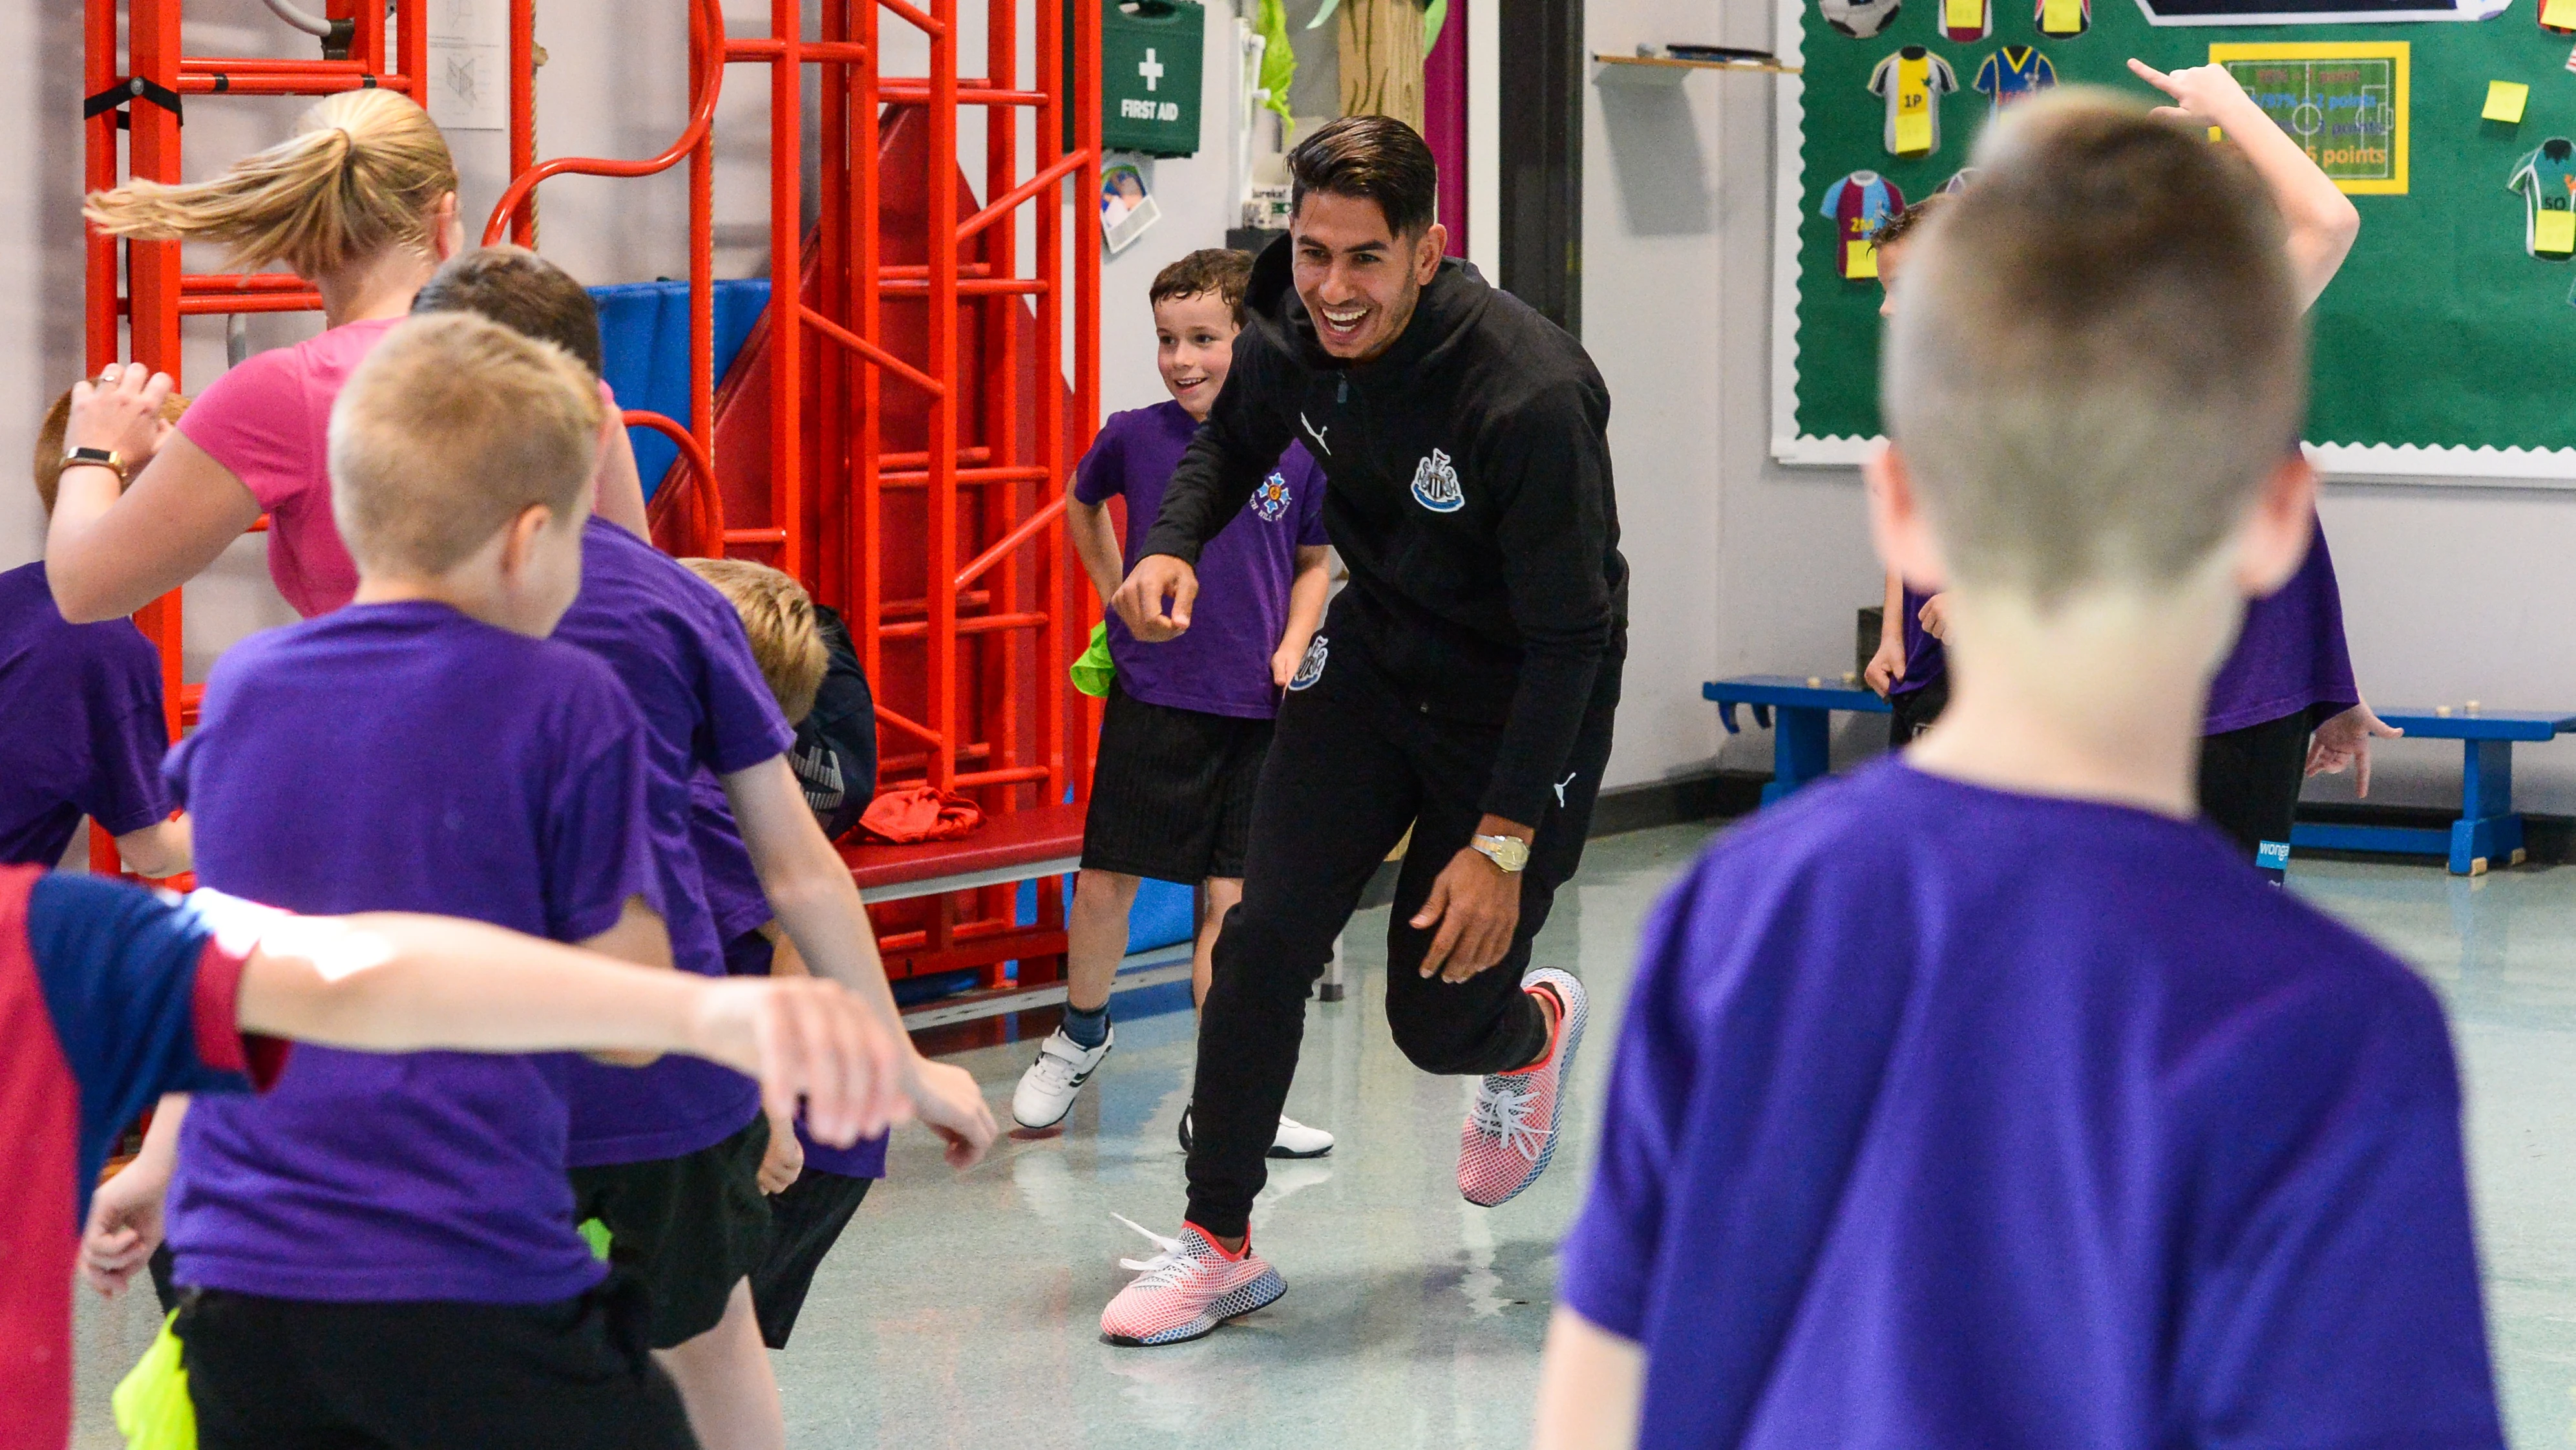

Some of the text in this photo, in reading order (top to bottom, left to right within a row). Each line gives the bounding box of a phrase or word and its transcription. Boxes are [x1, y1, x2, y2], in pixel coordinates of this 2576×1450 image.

[1121, 99, 1178, 121] FIRST AID
[1905, 94, 1921, 108] 1P
[2328, 93, 2376, 111] points
[2323, 145, 2386, 168] points
